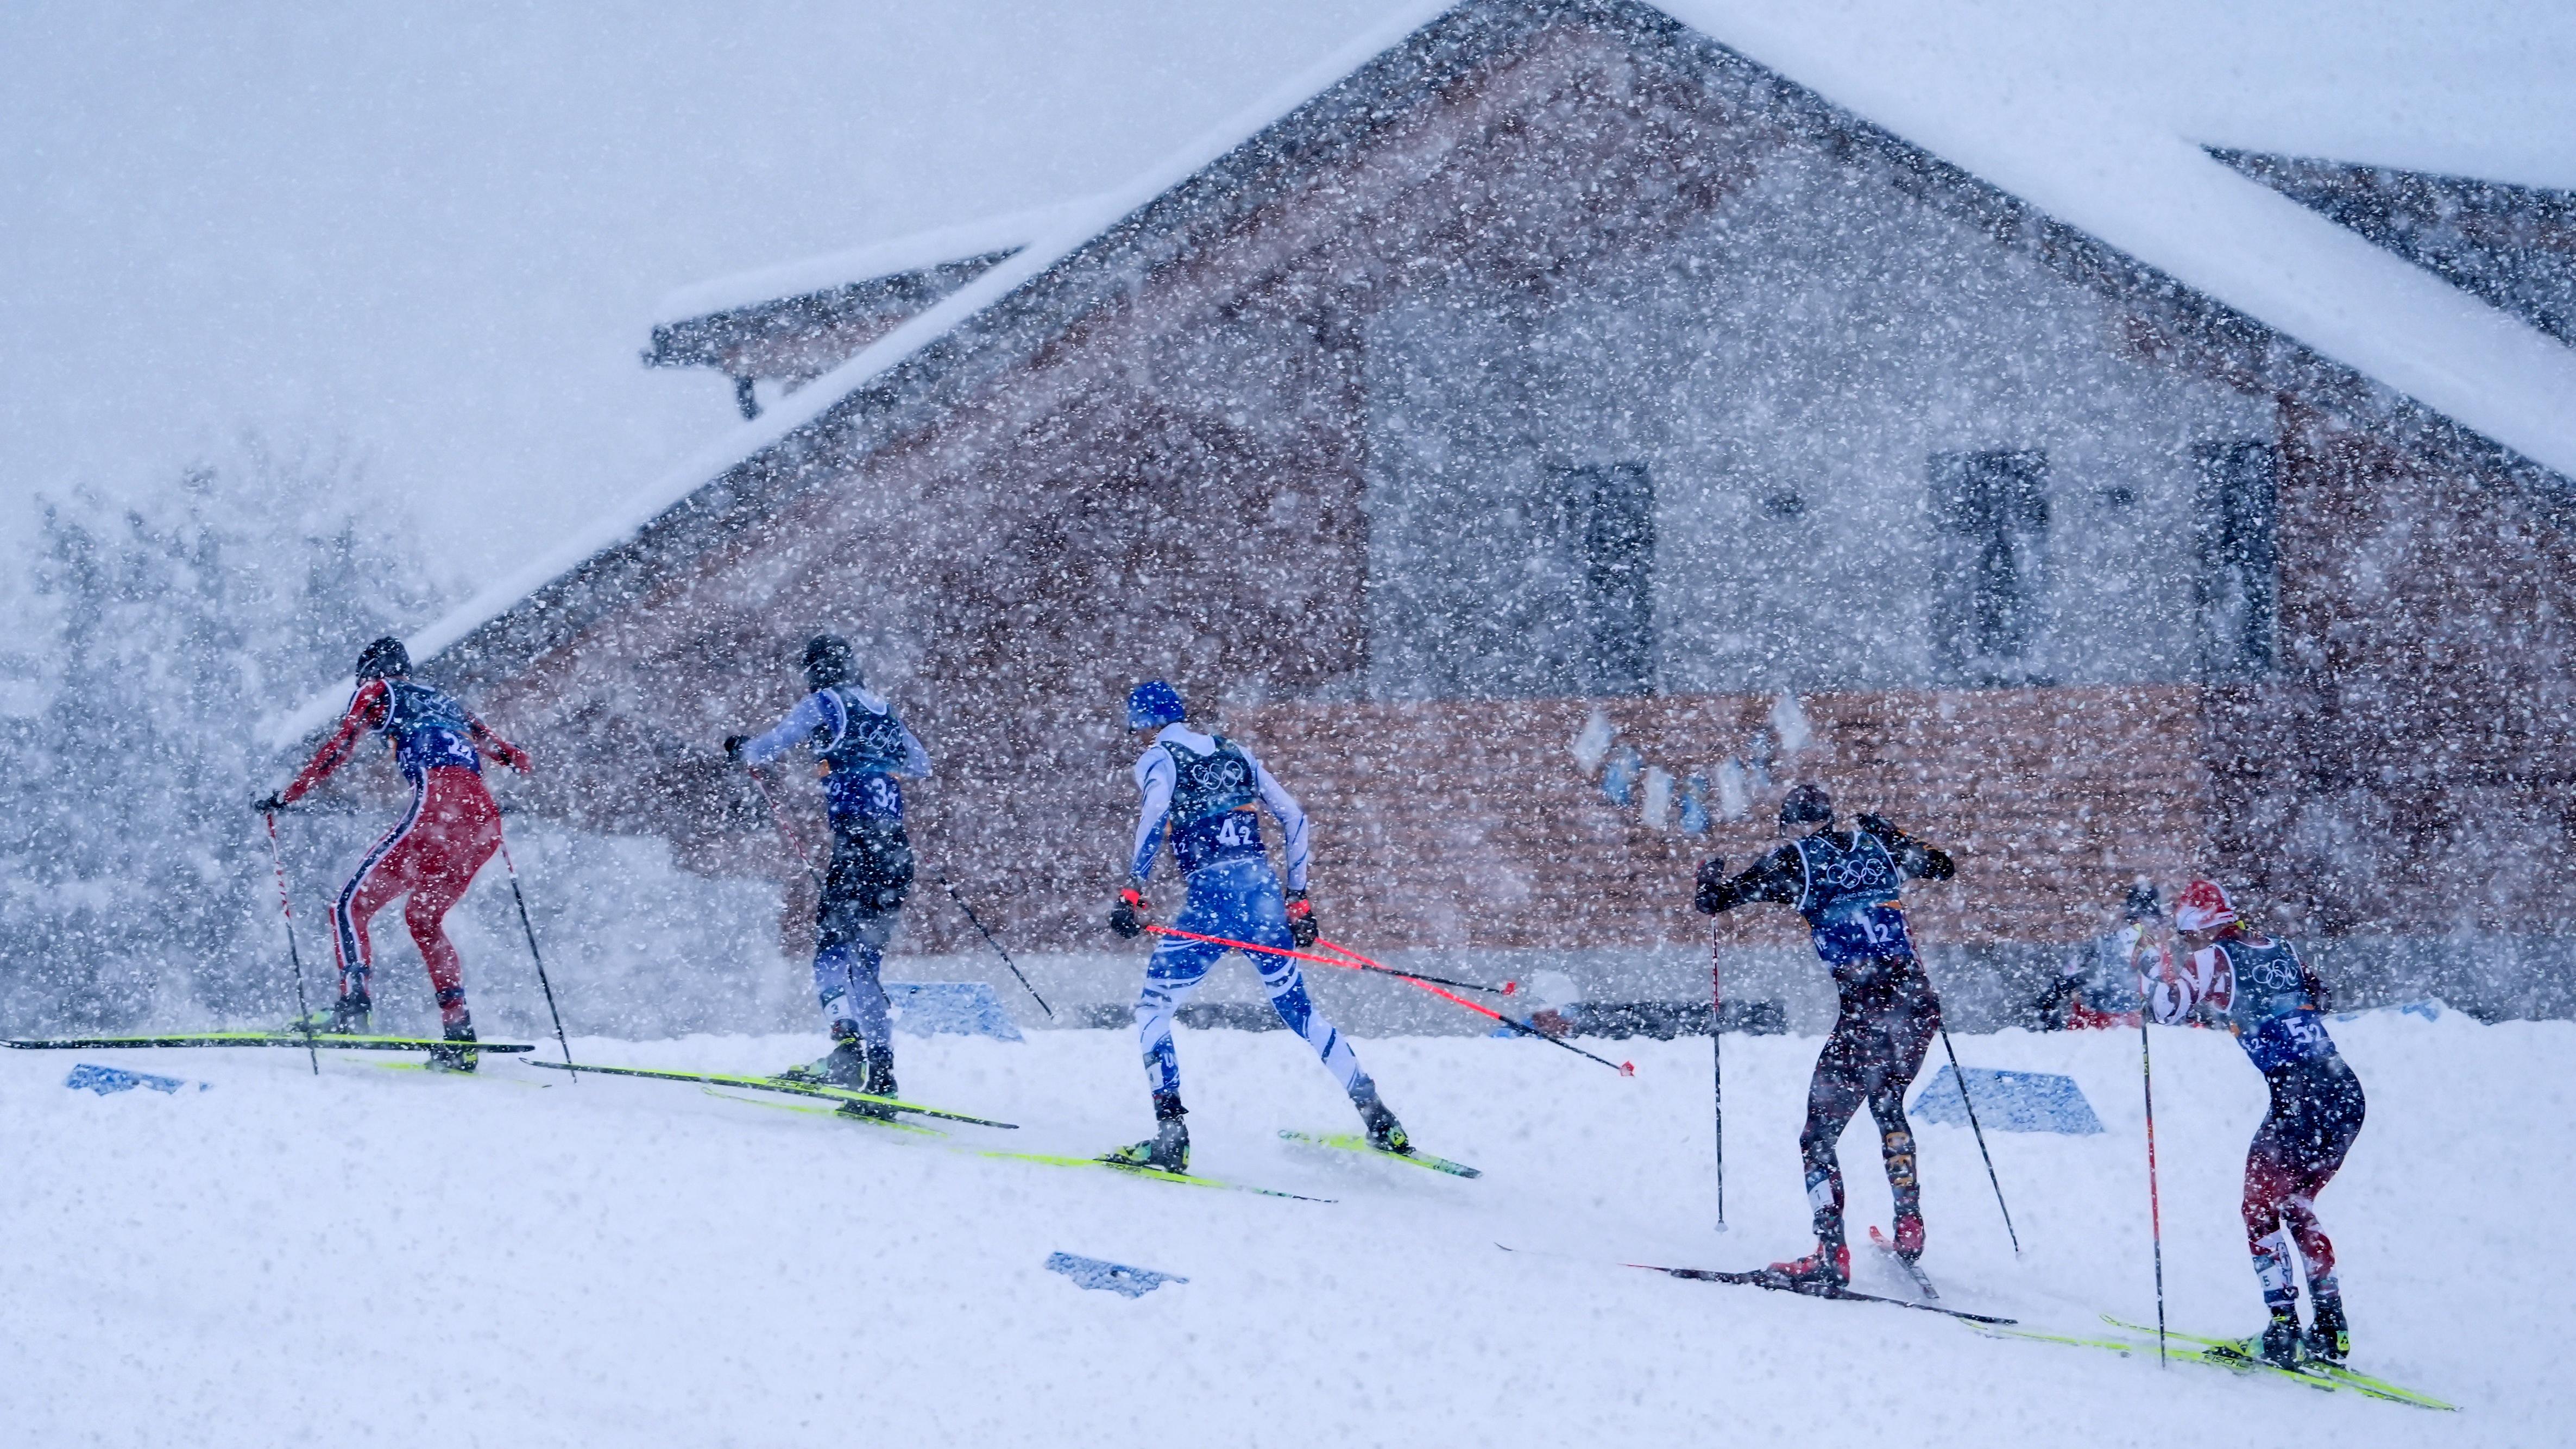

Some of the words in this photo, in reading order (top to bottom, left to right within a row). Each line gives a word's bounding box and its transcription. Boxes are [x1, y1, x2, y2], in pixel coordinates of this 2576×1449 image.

[2284, 1016, 2322, 1043] 52
[2263, 1275, 2270, 1287] 5
[2204, 1354, 2254, 1369] FISCHE
